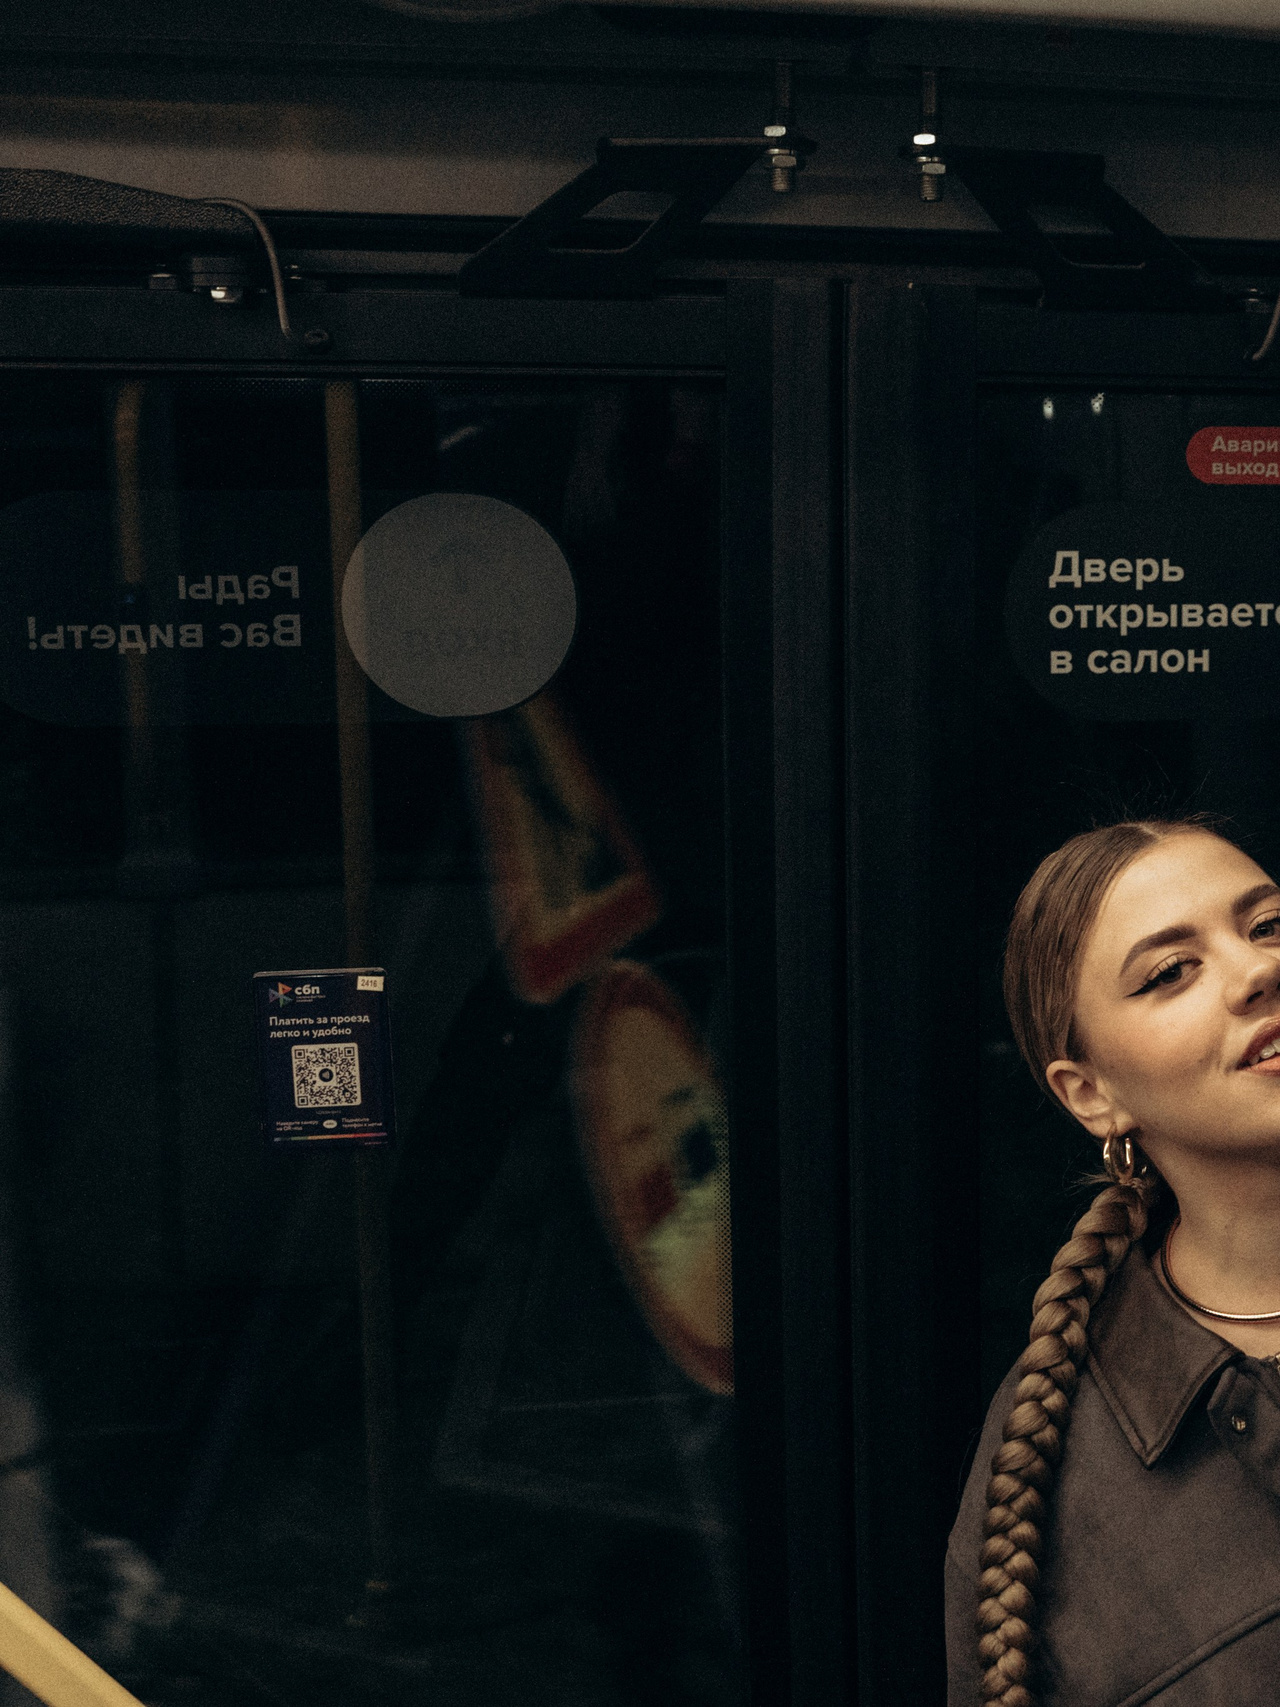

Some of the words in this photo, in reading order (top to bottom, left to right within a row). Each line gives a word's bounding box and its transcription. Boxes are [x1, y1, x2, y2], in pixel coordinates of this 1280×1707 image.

[1212, 462, 1279, 477] выход
[1049, 551, 1184, 590] Дверь
[1051, 651, 1072, 674] в
[1088, 649, 1209, 674] салон
[361, 979, 378, 987] 2416
[295, 984, 320, 995] сбп
[269, 1016, 314, 1026] Платить
[330, 1015, 370, 1025] проезд
[270, 1030, 300, 1038] легко
[312, 1026, 352, 1038] удобно
